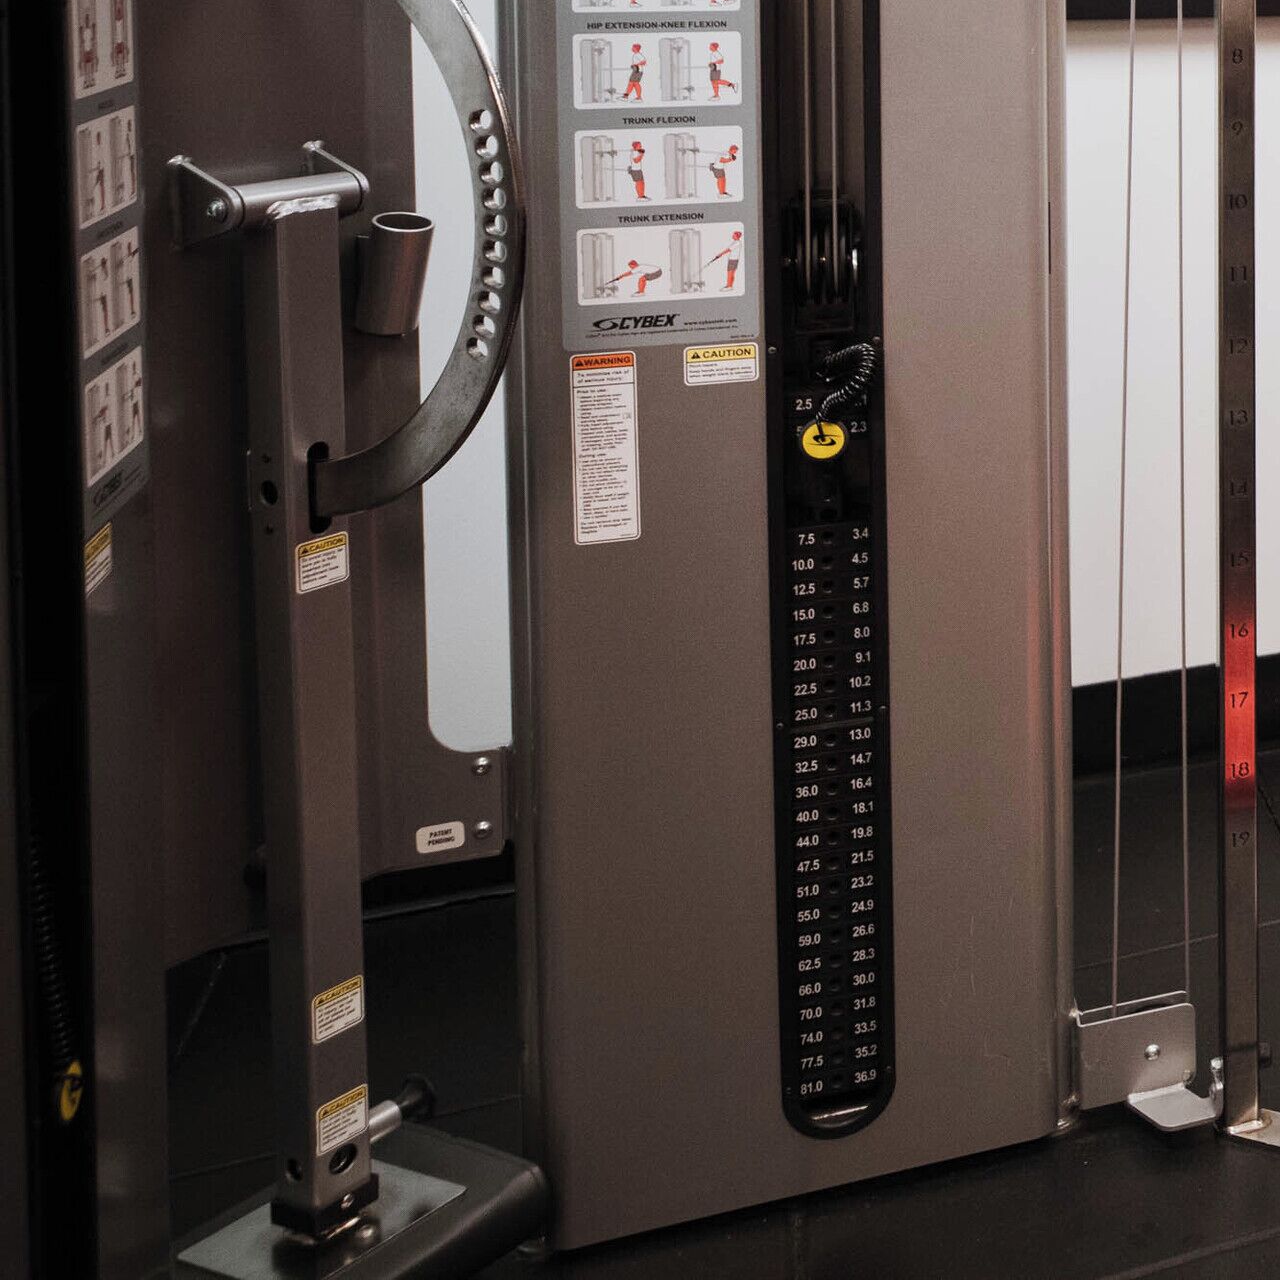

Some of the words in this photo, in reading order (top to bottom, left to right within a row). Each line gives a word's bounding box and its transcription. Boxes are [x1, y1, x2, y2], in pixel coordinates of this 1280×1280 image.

[688, 20, 727, 28] FLEXION
[1232, 48, 1244, 64] 8
[656, 116, 696, 124] FLEXION
[1232, 121, 1243, 136] 9
[1229, 194, 1247, 210] 10
[618, 215, 649, 223] TRUNK
[652, 213, 704, 221] EXTENSION
[1230, 266, 1247, 281] 11
[619, 314, 676, 330] CYBEX
[702, 348, 751, 359] CAUTION
[1229, 338, 1247, 354] 12
[584, 356, 630, 366] WARNING
[794, 398, 813, 411] 2.5
[1229, 410, 1248, 426] 13
[851, 420, 867, 433] 2.3
[797, 533, 816, 546] 7.5
[852, 528, 870, 540] 3.4
[791, 558, 815, 572] 10.0
[851, 552, 870, 565] 4.5
[792, 582, 817, 597] 12.5
[853, 576, 871, 589] 5.7
[792, 608, 816, 622] 15.0
[852, 602, 870, 615] 6.8
[853, 626, 871, 640] 8.0
[1229, 623, 1249, 639] 16
[793, 633, 817, 647] 17.5
[855, 650, 872, 664] 9.1
[793, 658, 817, 672] 20.0
[794, 682, 818, 697] 22.5
[849, 675, 873, 690] 10.2
[850, 700, 873, 714] 11.3
[1230, 692, 1249, 708] 17
[794, 708, 818, 722] 25.0
[794, 735, 818, 749] 29.0
[849, 728, 872, 741] 13.0
[850, 752, 873, 766] 14.7
[794, 760, 819, 774] 32.5
[1230, 761, 1250, 778] 18
[850, 776, 873, 791] 16.4
[795, 784, 819, 799] 36.0
[852, 801, 875, 815] 18.1
[796, 809, 820, 823] 40.0
[851, 826, 874, 840] 19.8
[796, 834, 820, 848] 44.0
[851, 850, 875, 865] 21.5
[797, 859, 821, 874] 47.5
[851, 875, 875, 890] 23.2
[796, 884, 821, 898] 51.0
[851, 899, 875, 914] 24.9
[797, 908, 821, 923] 55.0
[852, 923, 876, 938] 26.6
[798, 933, 822, 948] 59.0
[852, 948, 876, 963] 28.3
[798, 957, 822, 972] 62.5
[852, 972, 876, 987] 30.0
[798, 982, 822, 997] 66.0
[853, 996, 877, 1011] 31.8
[799, 1007, 824, 1021] 70.0
[854, 1020, 878, 1035] 33.5
[800, 1031, 824, 1046] 74.0
[855, 1045, 879, 1060] 35.2
[800, 1055, 825, 1070] 77.5
[854, 1070, 877, 1084] 36.9
[800, 1081, 824, 1096] 81.0
